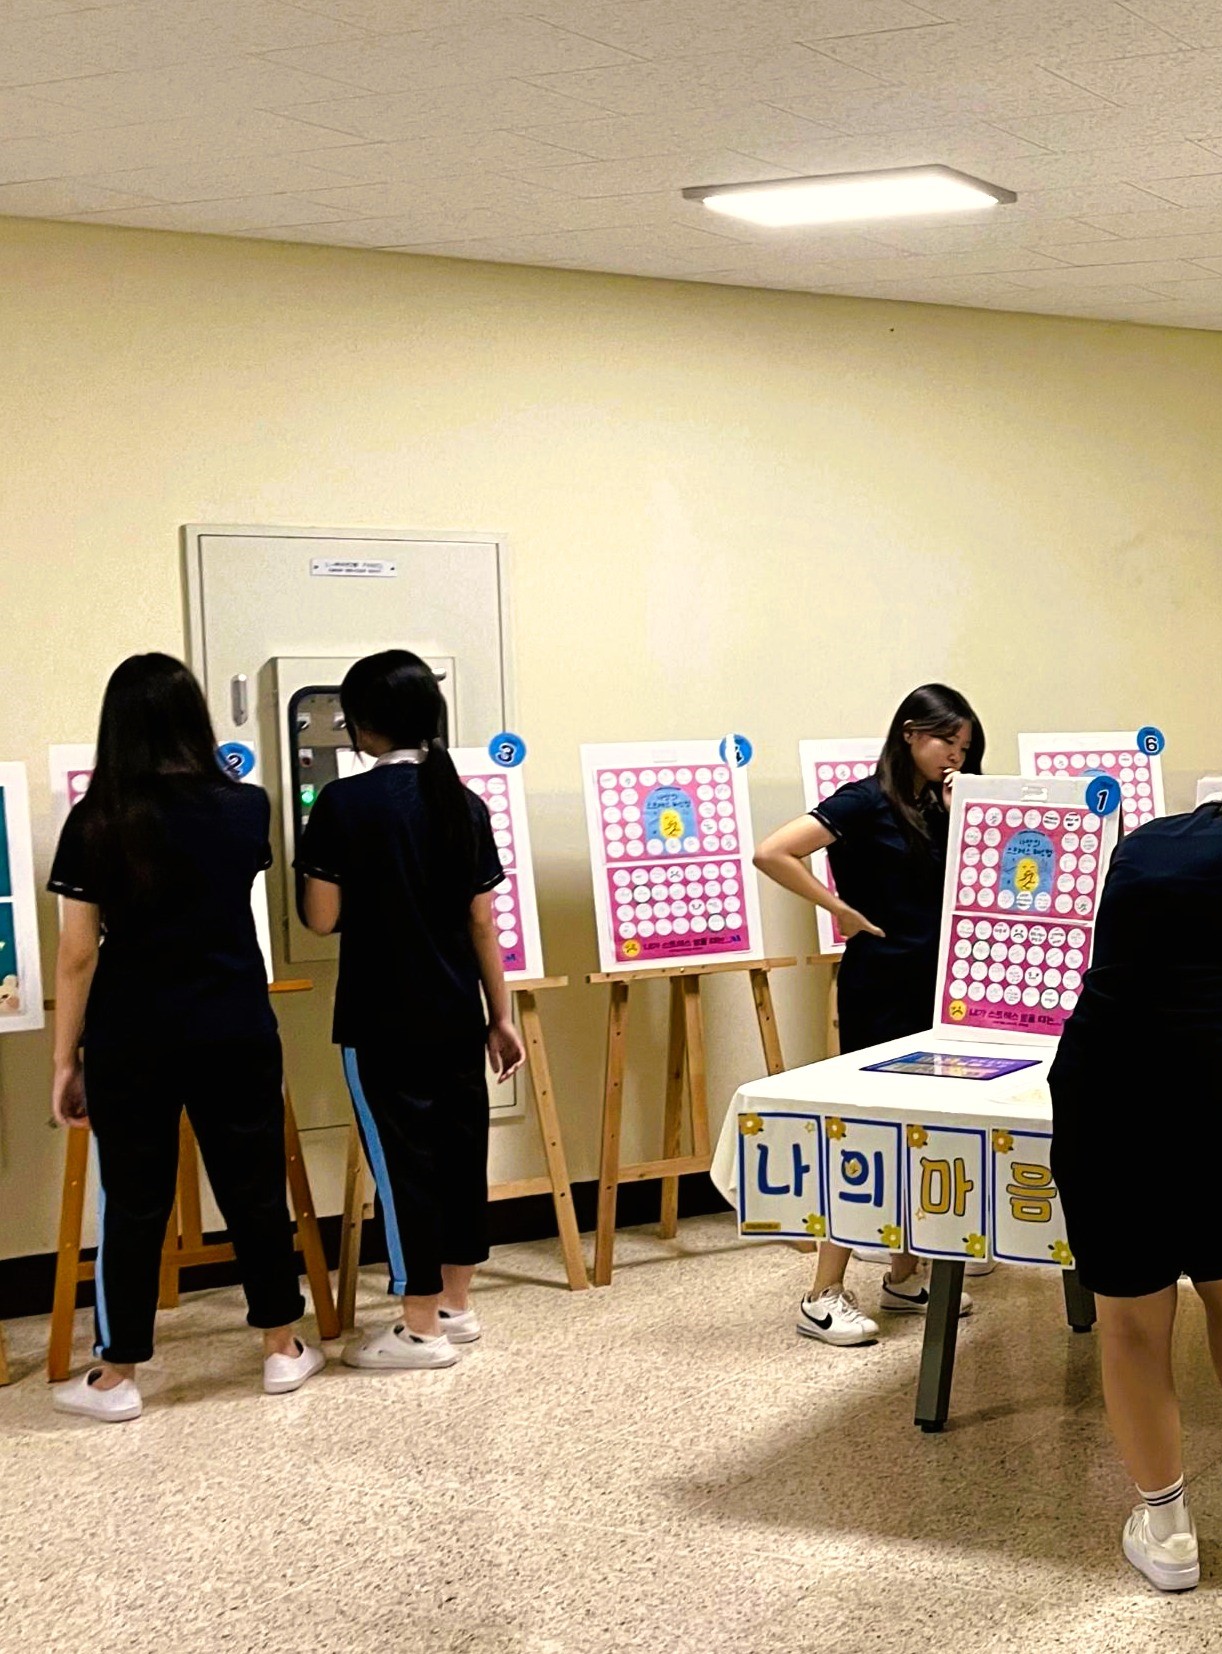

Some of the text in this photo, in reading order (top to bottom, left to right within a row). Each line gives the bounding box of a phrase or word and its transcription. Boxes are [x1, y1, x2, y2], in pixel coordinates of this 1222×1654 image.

[497, 743, 514, 763] 3
[1145, 736, 1158, 752] 6
[225, 754, 243, 774] 2
[1097, 789, 1108, 812] 1
[756, 1142, 884, 1208] 나의
[919, 1156, 1057, 1223] 마음
